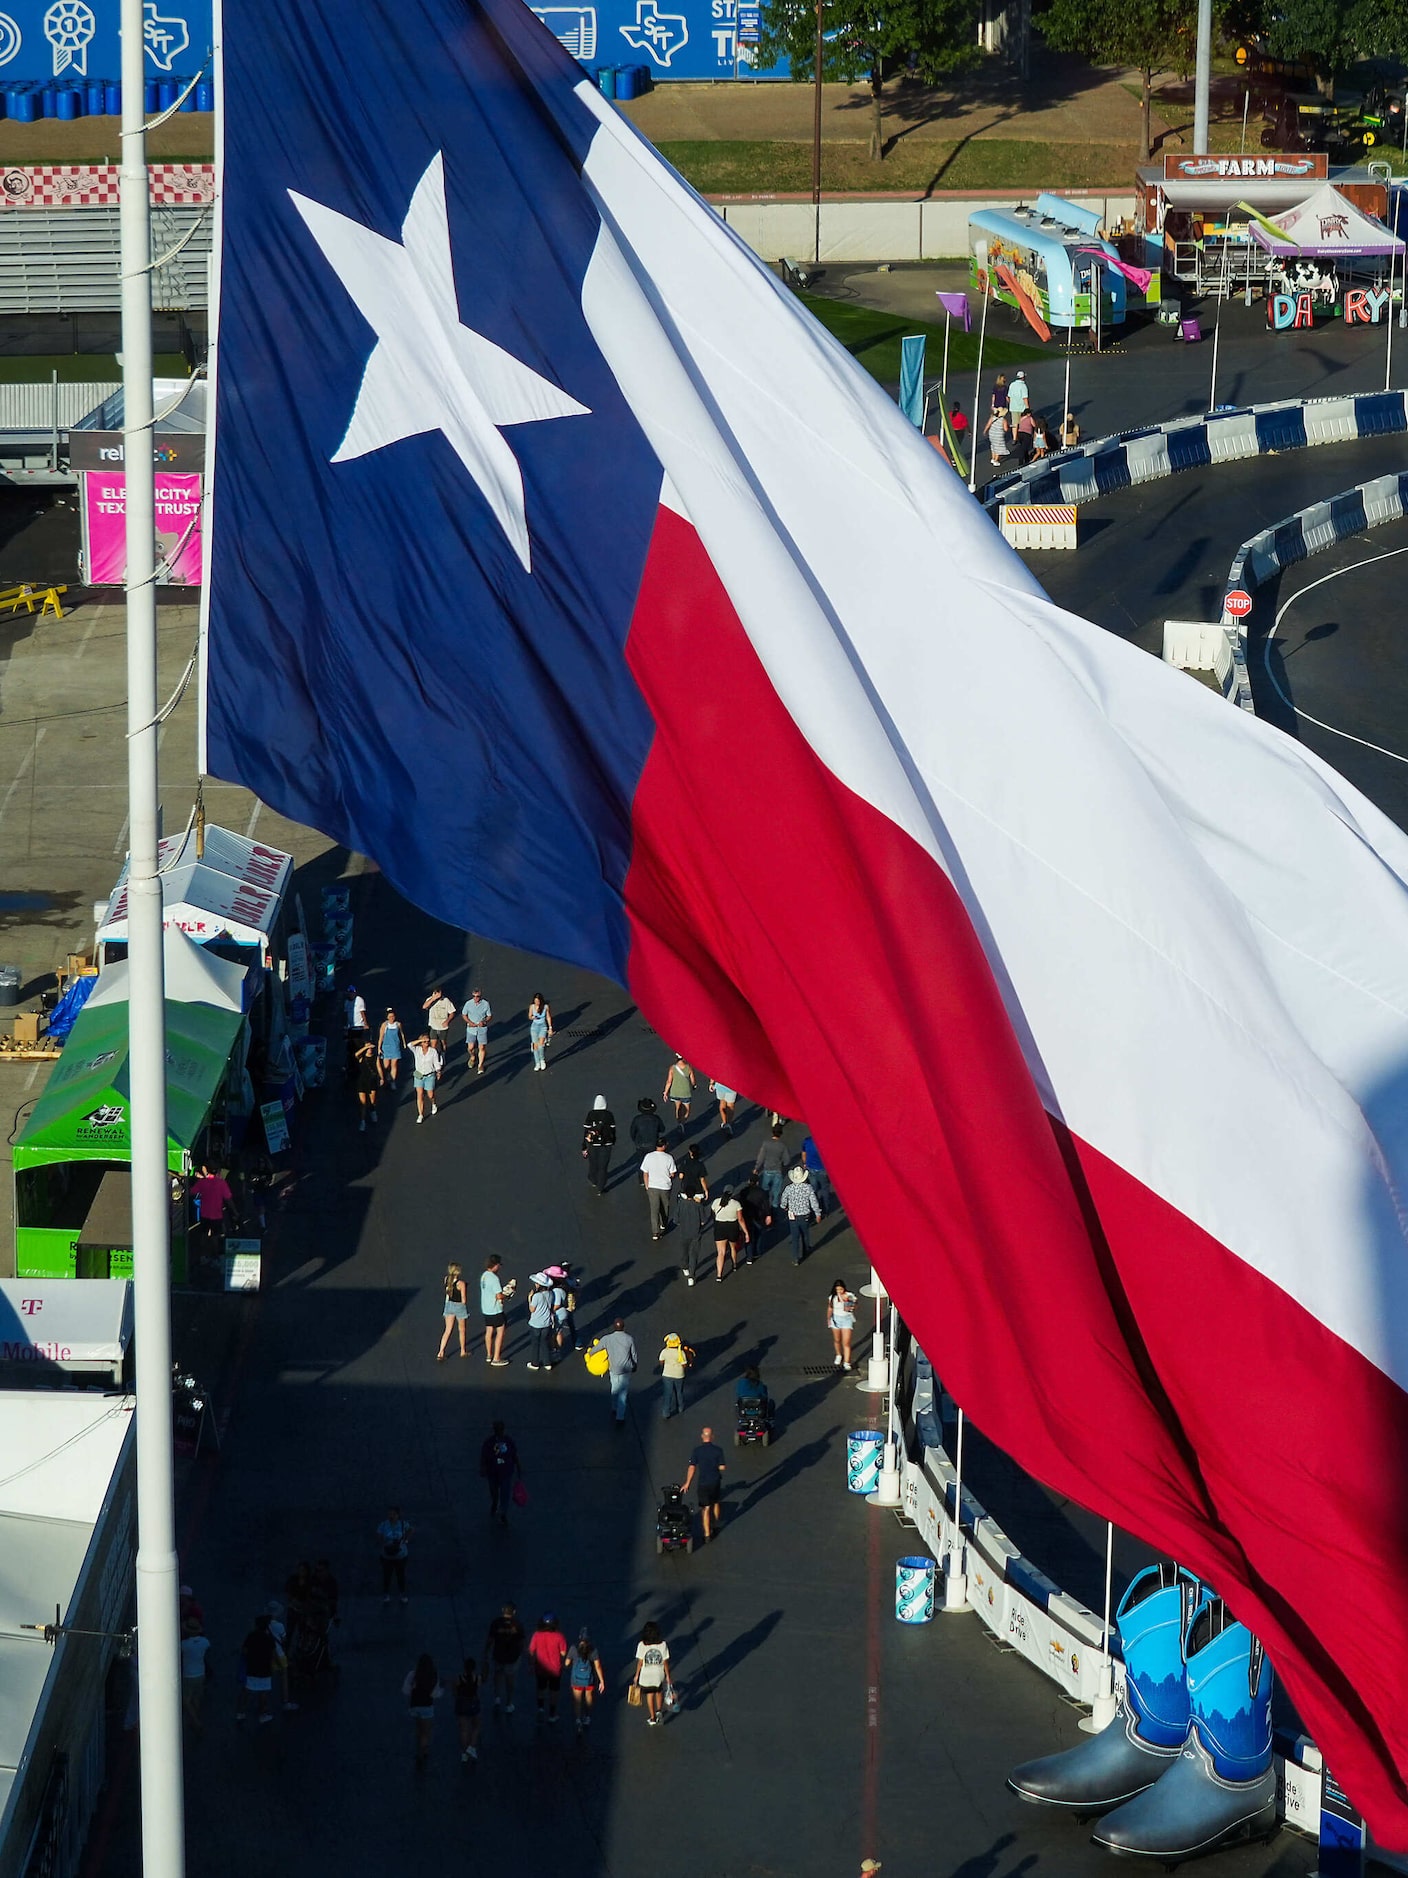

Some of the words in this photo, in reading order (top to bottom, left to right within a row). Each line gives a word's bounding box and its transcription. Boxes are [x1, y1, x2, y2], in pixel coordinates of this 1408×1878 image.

[1219, 159, 1275, 176] FARM
[103, 488, 192, 500] ELEICITY
[1226, 598, 1250, 609] STOP
[3, 1342, 72, 1361] Mobile
